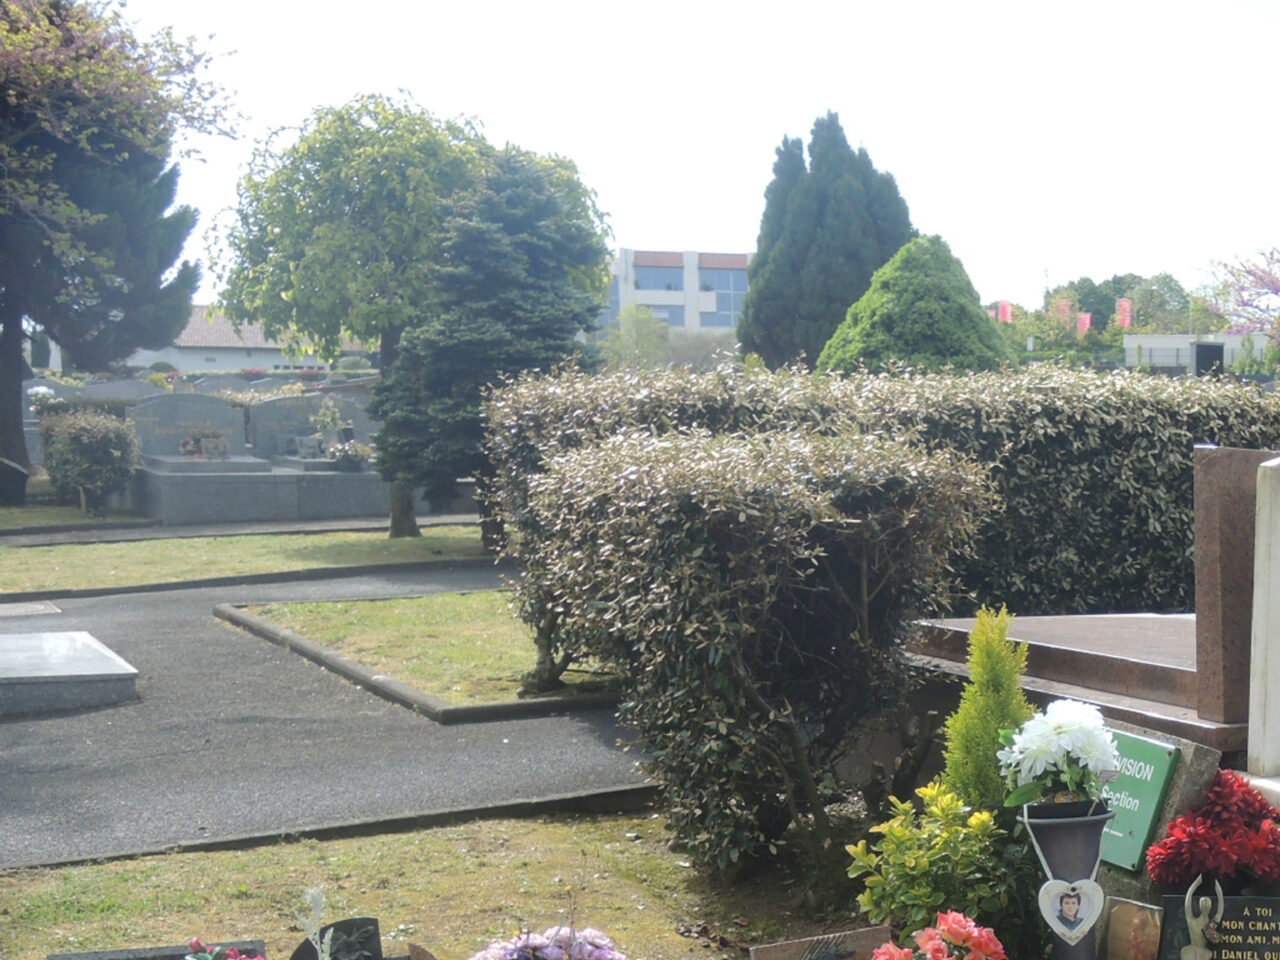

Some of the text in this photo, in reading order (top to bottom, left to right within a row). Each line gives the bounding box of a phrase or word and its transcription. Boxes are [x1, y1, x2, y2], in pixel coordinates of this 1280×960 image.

[1115, 755, 1154, 781] VISION
[1243, 907, 1250, 917] A
[1256, 907, 1272, 917] TOI
[1222, 921, 1244, 930] MON
[1222, 935, 1243, 944] MON
[1222, 950, 1260, 960] DANIEL
